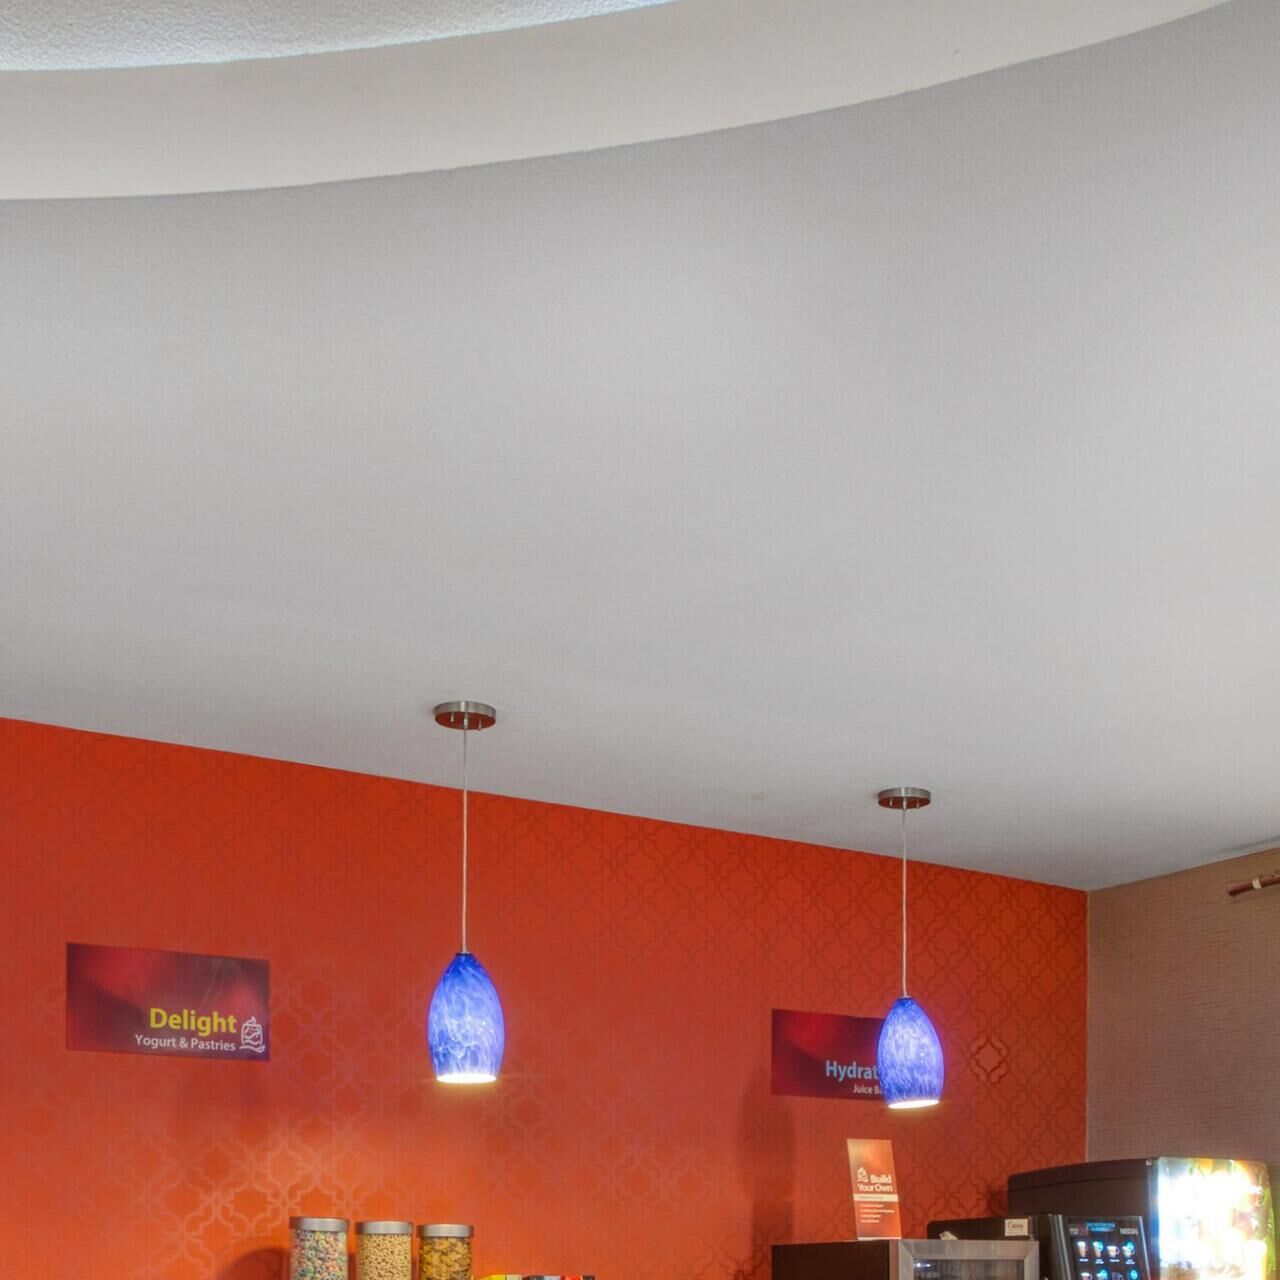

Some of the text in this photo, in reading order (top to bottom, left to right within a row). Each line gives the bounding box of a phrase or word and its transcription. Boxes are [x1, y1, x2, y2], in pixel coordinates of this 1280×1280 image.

[149, 1007, 237, 1037] Delight
[134, 1034, 236, 1051] Yogurt & Pastries
[825, 1060, 878, 1082] Hydrat
[853, 1084, 872, 1094] Juice
[870, 1174, 892, 1184] Build
[857, 1183, 893, 1192] Your Own
